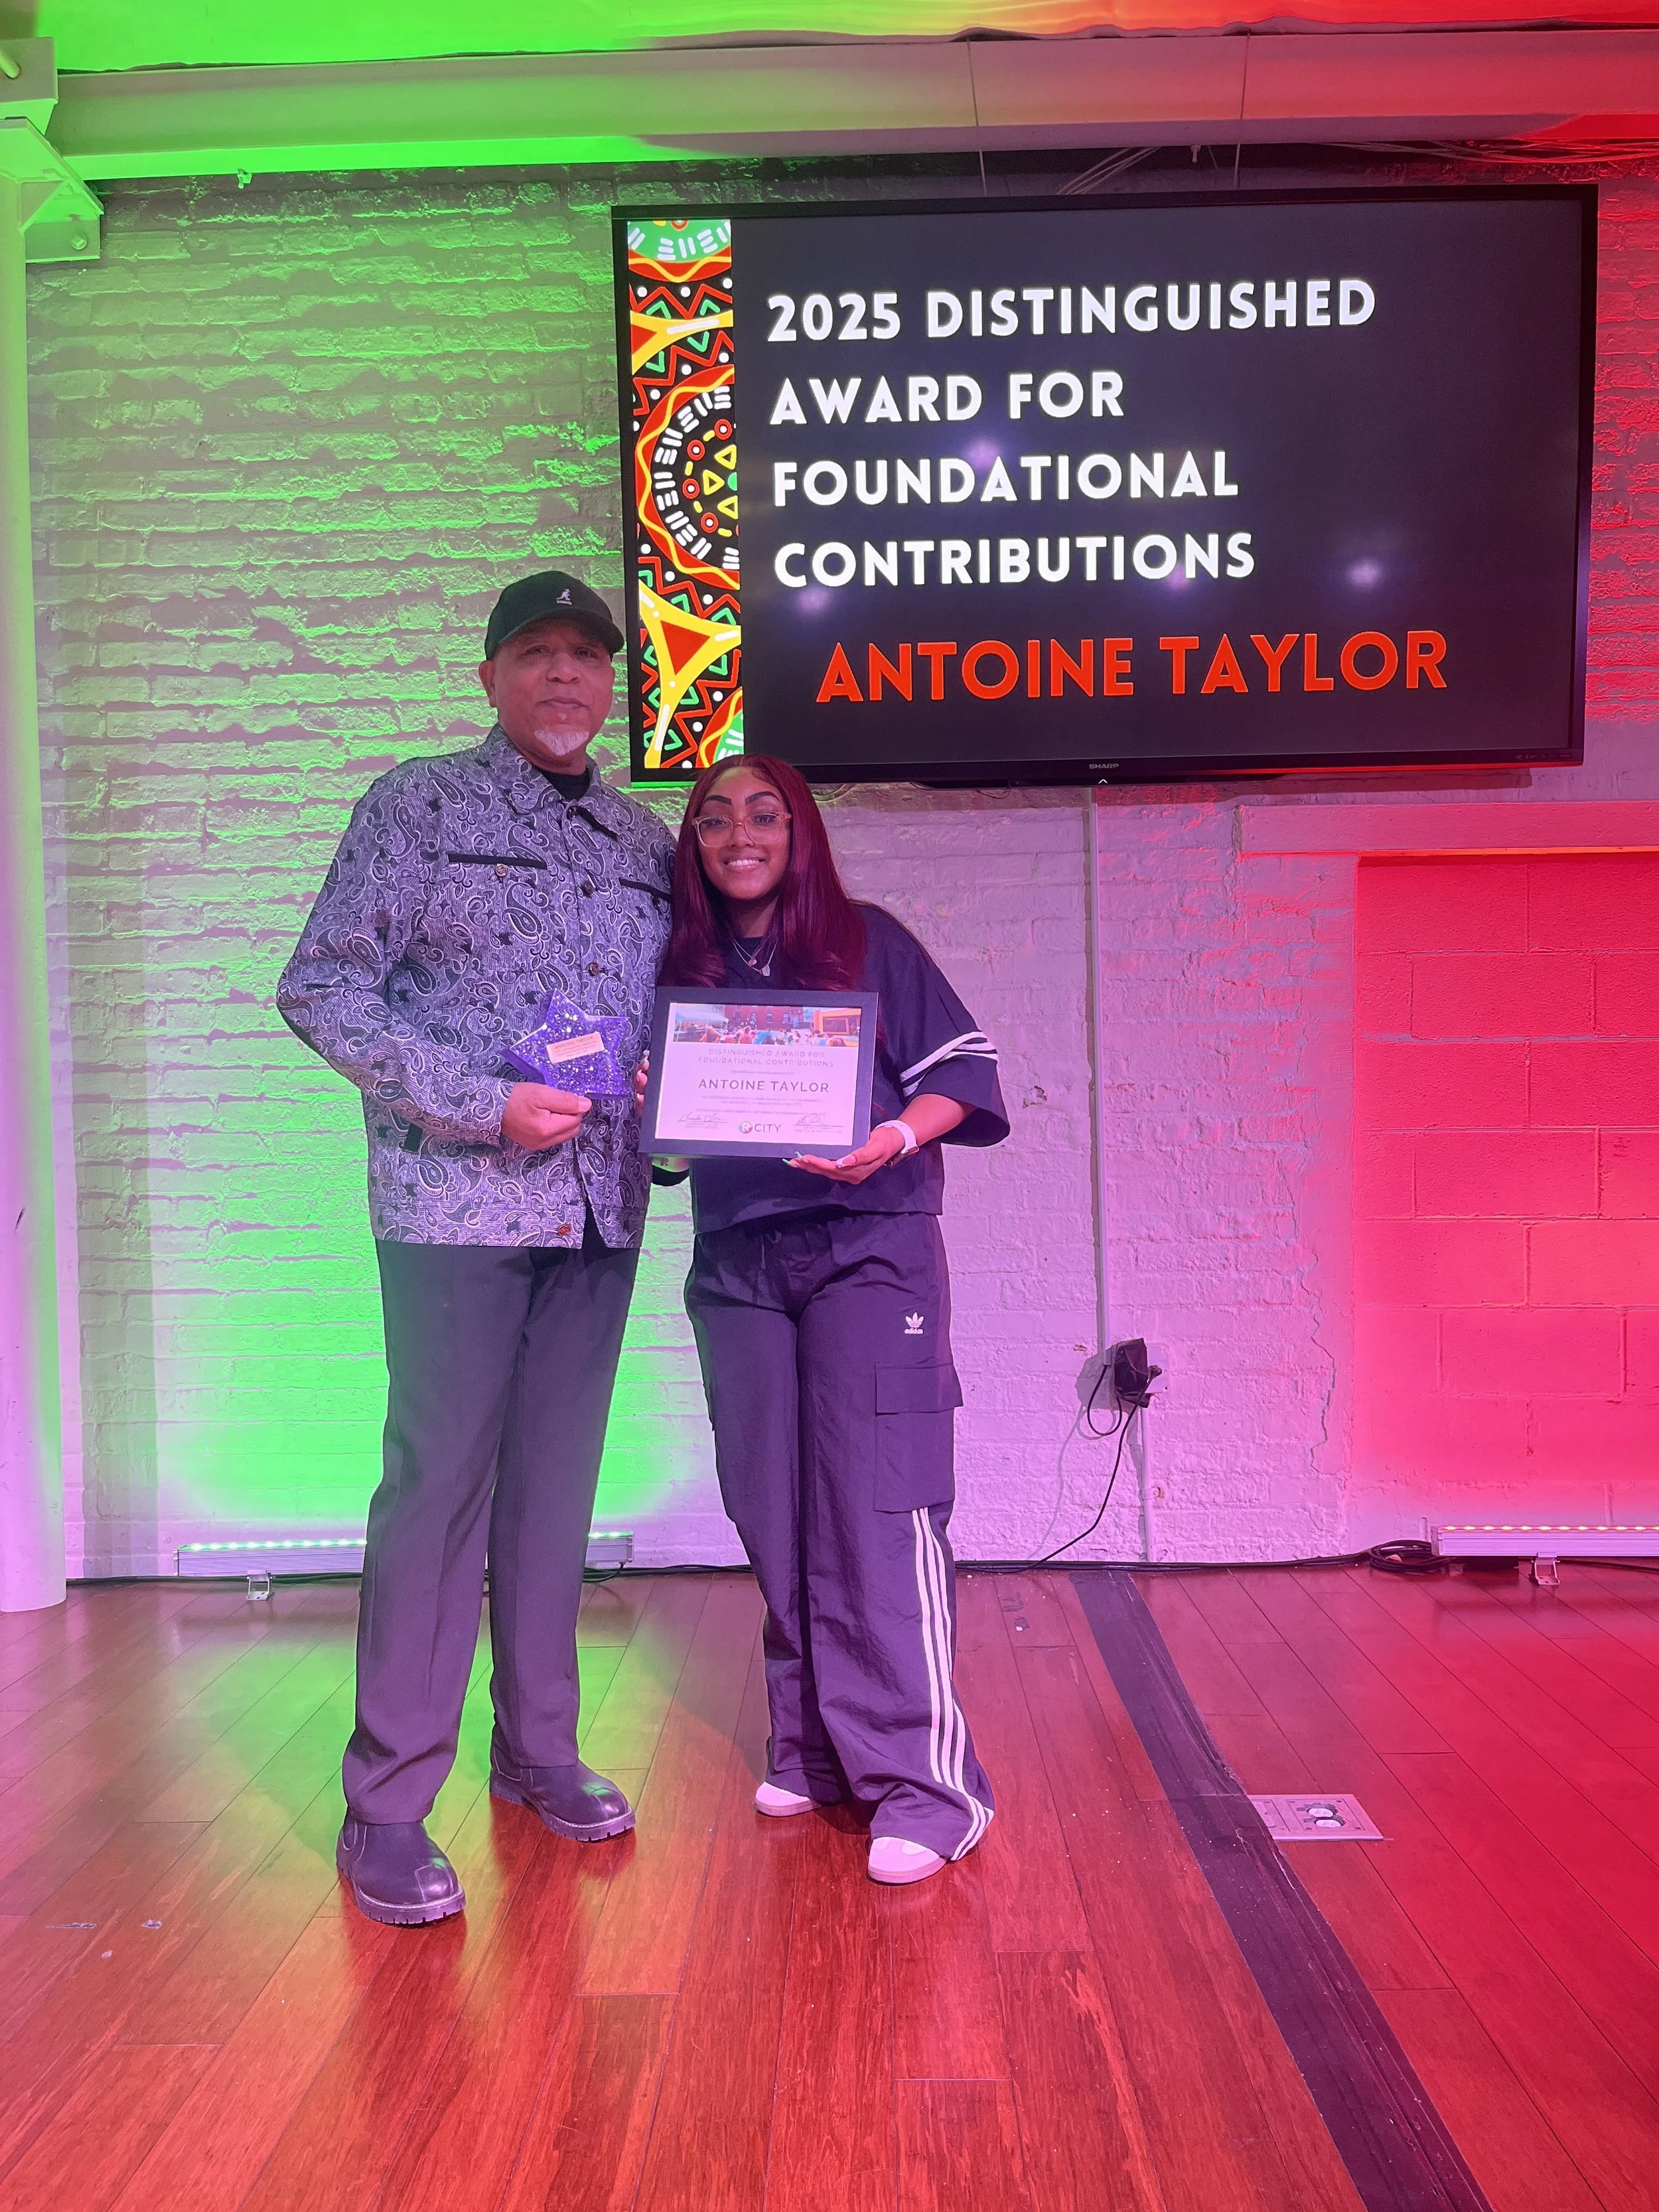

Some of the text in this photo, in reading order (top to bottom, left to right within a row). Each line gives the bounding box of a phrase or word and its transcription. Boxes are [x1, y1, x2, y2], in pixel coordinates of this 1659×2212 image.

[766, 279, 1376, 342] 2025 DISTINGUISHED
[769, 370, 1125, 425] AWARD FOR
[773, 451, 1239, 508] FOUNDATIONAL
[774, 532, 1255, 588] CONTRIBUTIONS
[816, 630, 1449, 703] ANTOINE TAYLOR
[698, 1078, 829, 1093] ANTOINE TAYLOR
